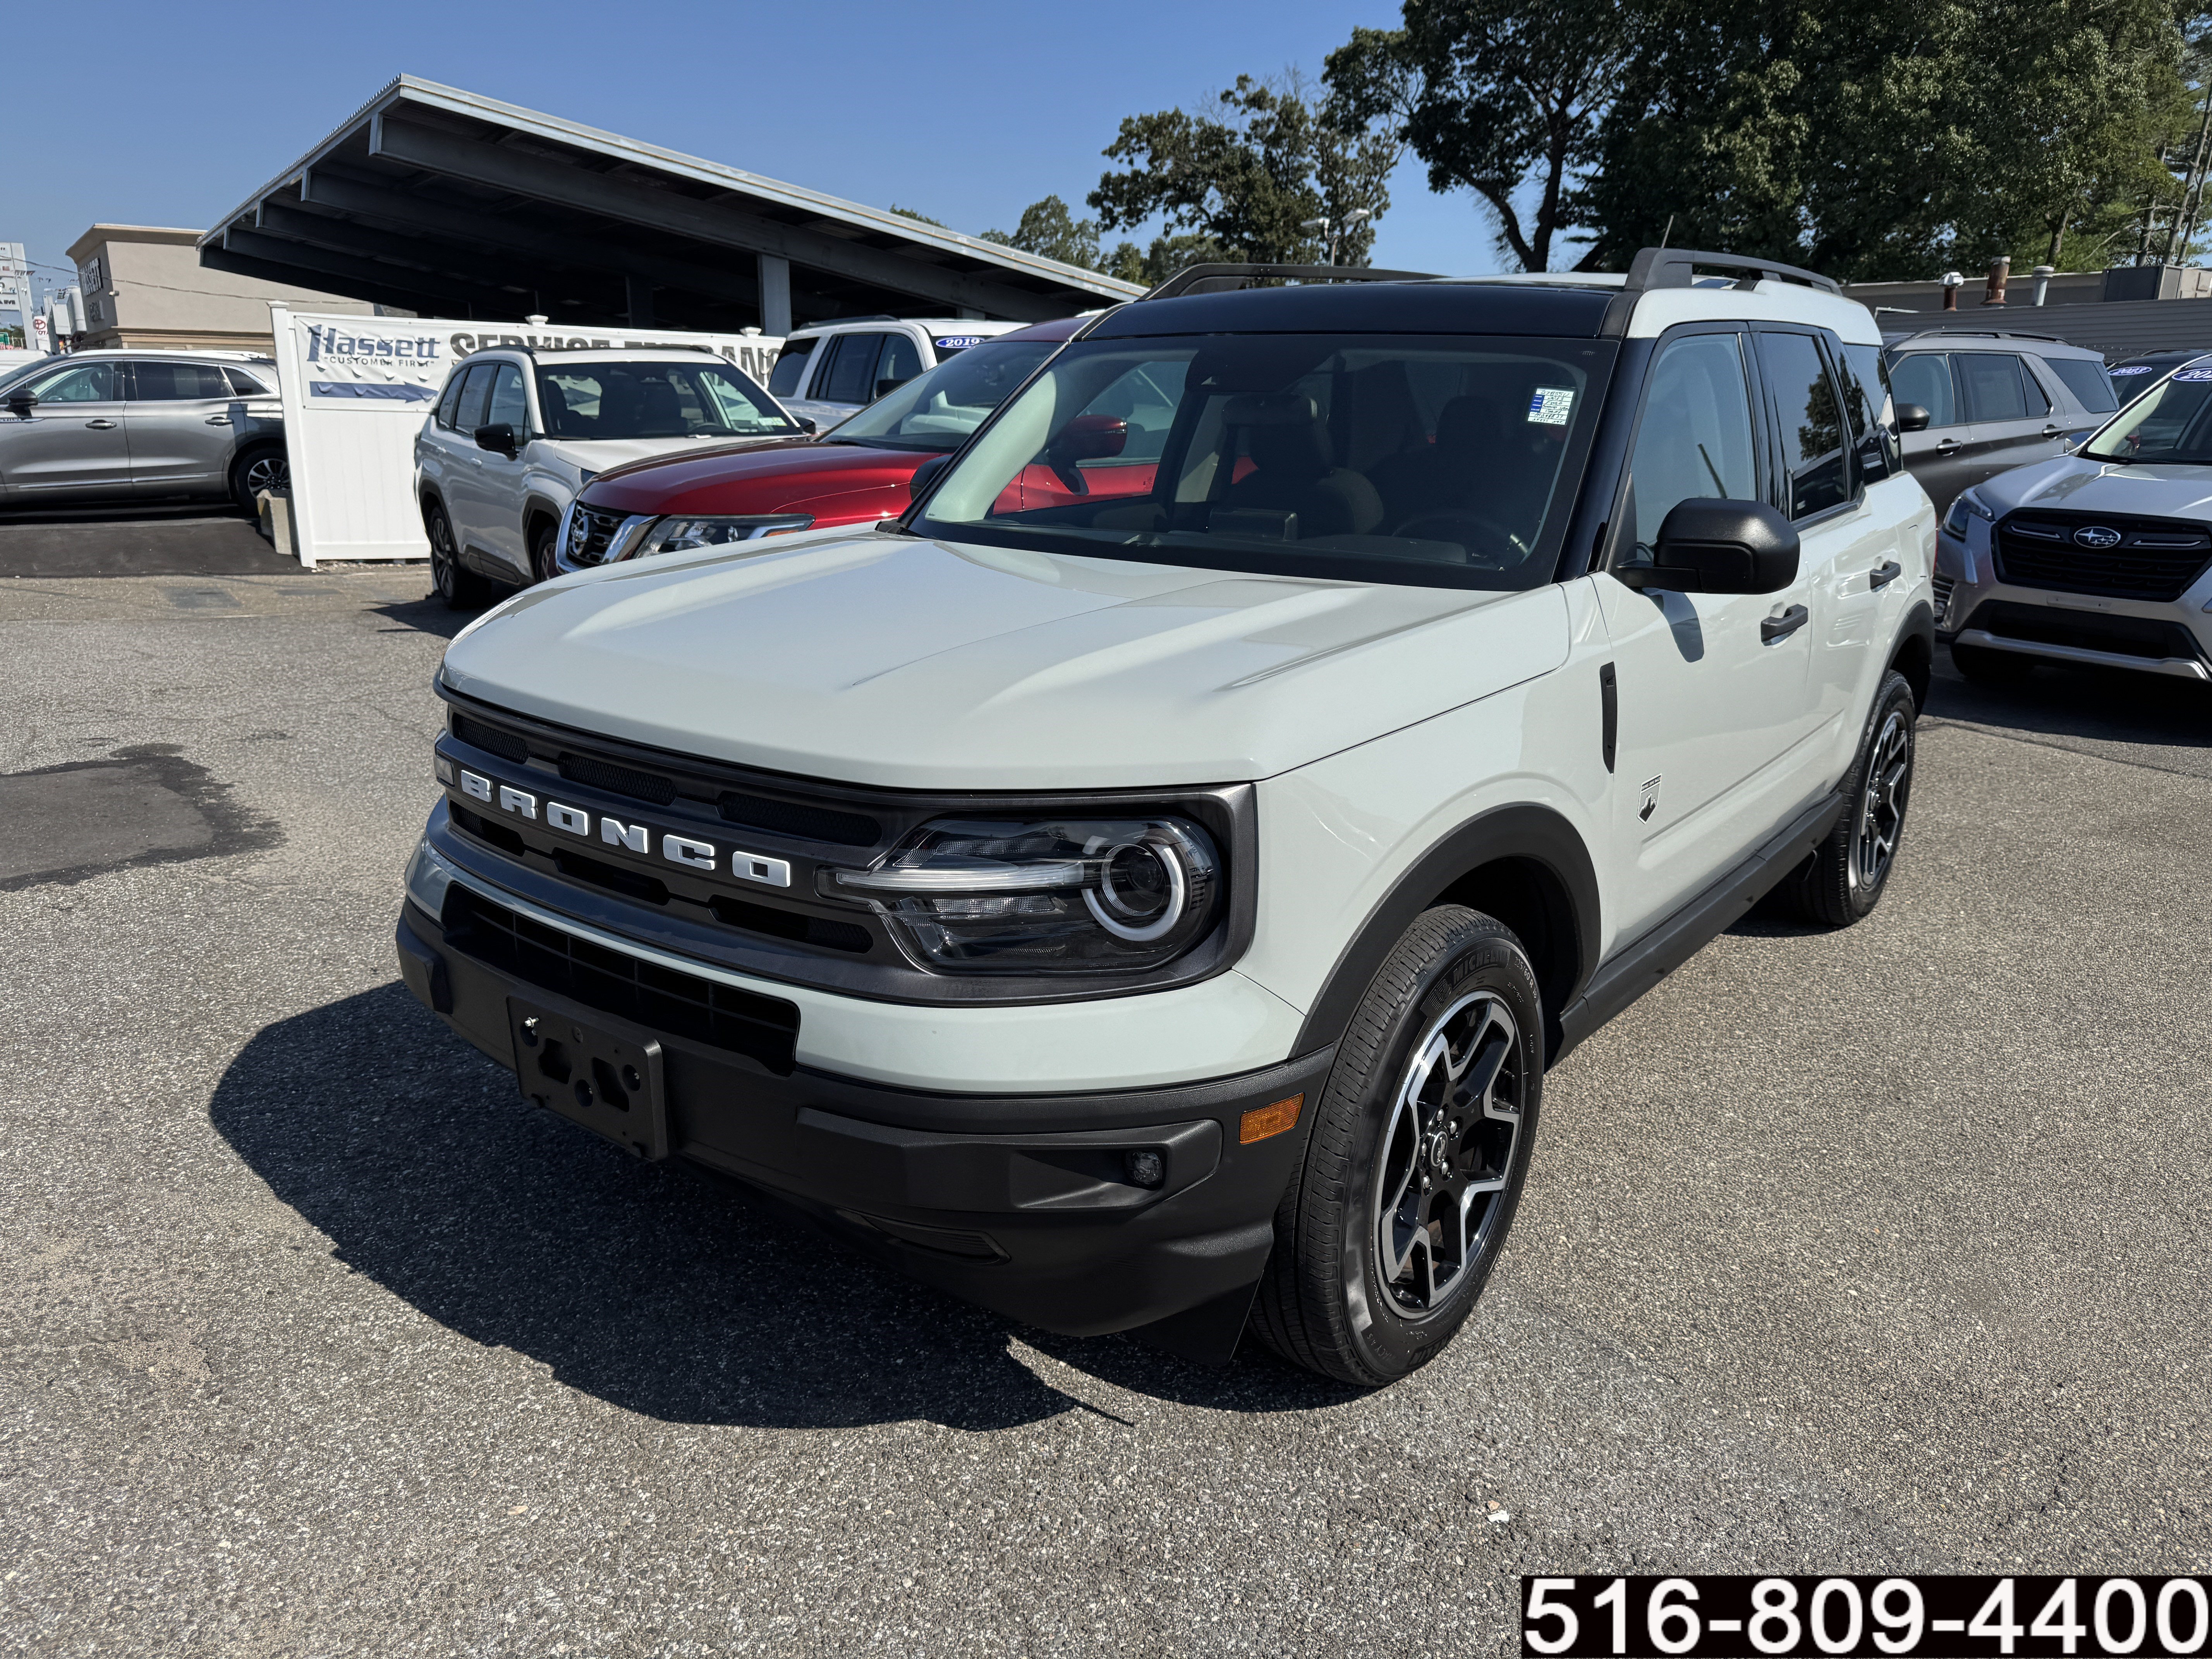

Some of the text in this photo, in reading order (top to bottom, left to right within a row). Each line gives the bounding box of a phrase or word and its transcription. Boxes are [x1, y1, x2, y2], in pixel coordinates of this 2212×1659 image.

[307, 325, 440, 361] Hassett
[945, 338, 981, 347] 2019
[461, 769, 791, 888] BRONCO
[1453, 950, 1508, 986] MICHELIN
